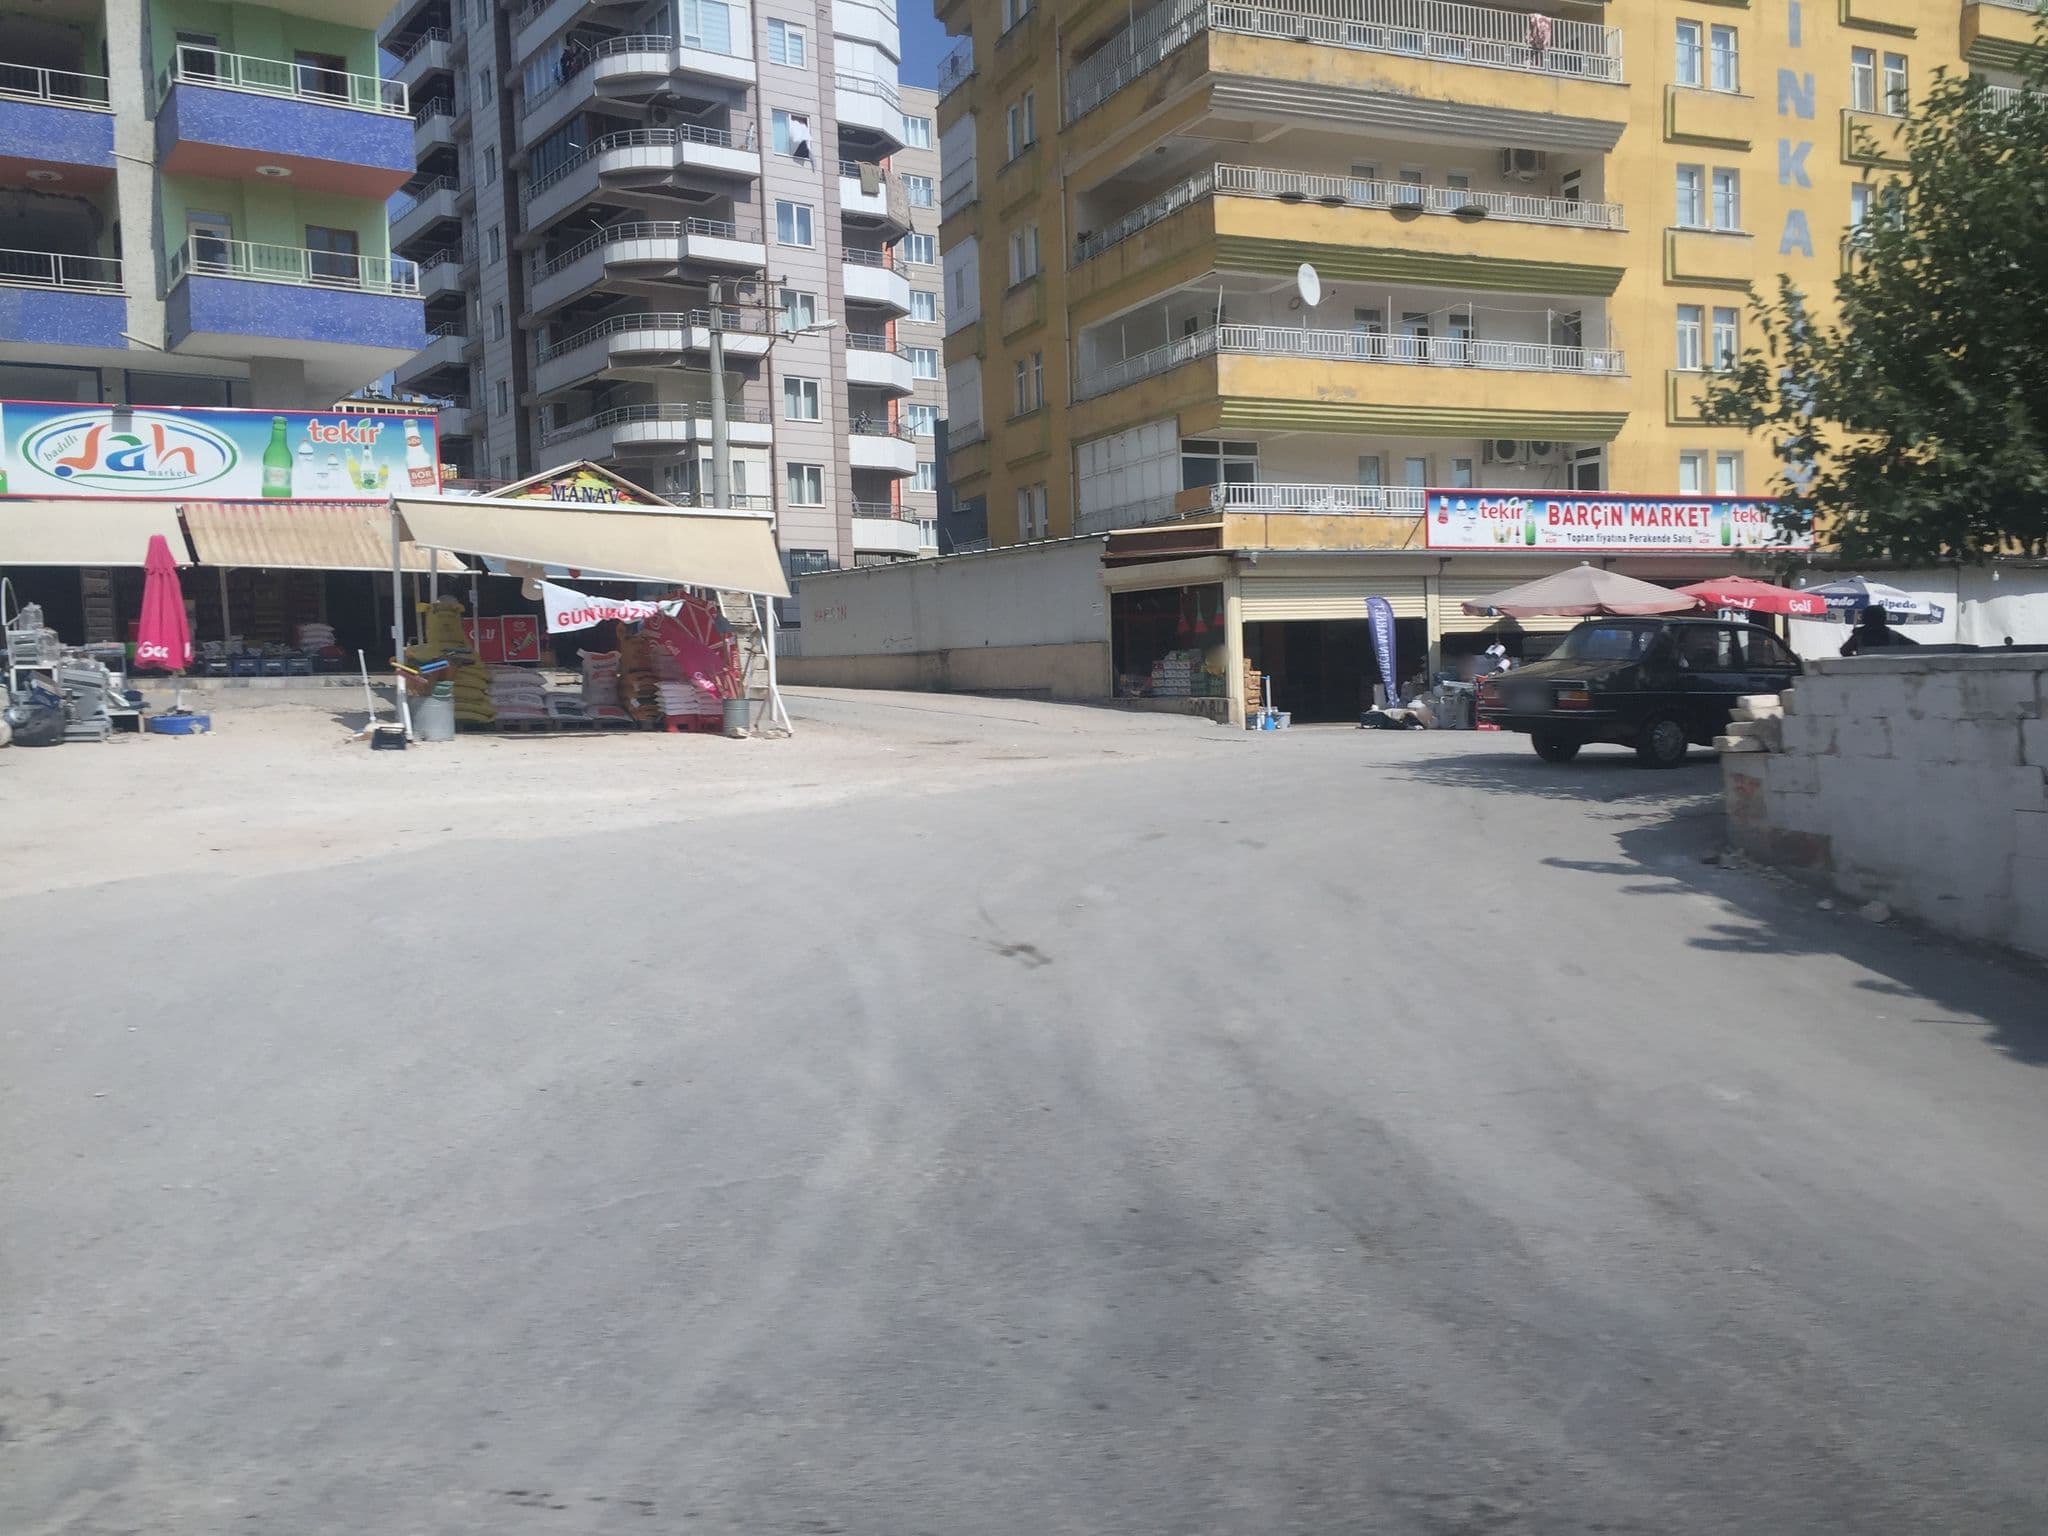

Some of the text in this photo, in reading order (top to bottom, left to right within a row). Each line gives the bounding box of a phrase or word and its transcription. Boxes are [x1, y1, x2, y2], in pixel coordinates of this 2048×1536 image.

[309, 418, 380, 444] tekir
[551, 482, 620, 504] MANAV
[1480, 498, 1523, 519] tekir
[1631, 505, 1711, 527] MARKET
[1567, 533, 1595, 544] Toptan
[1596, 533, 1627, 544] fiyatına
[1629, 533, 1671, 543] Perakende
[1672, 533, 1692, 544] Satış
[1788, 599, 1812, 612] Golf
